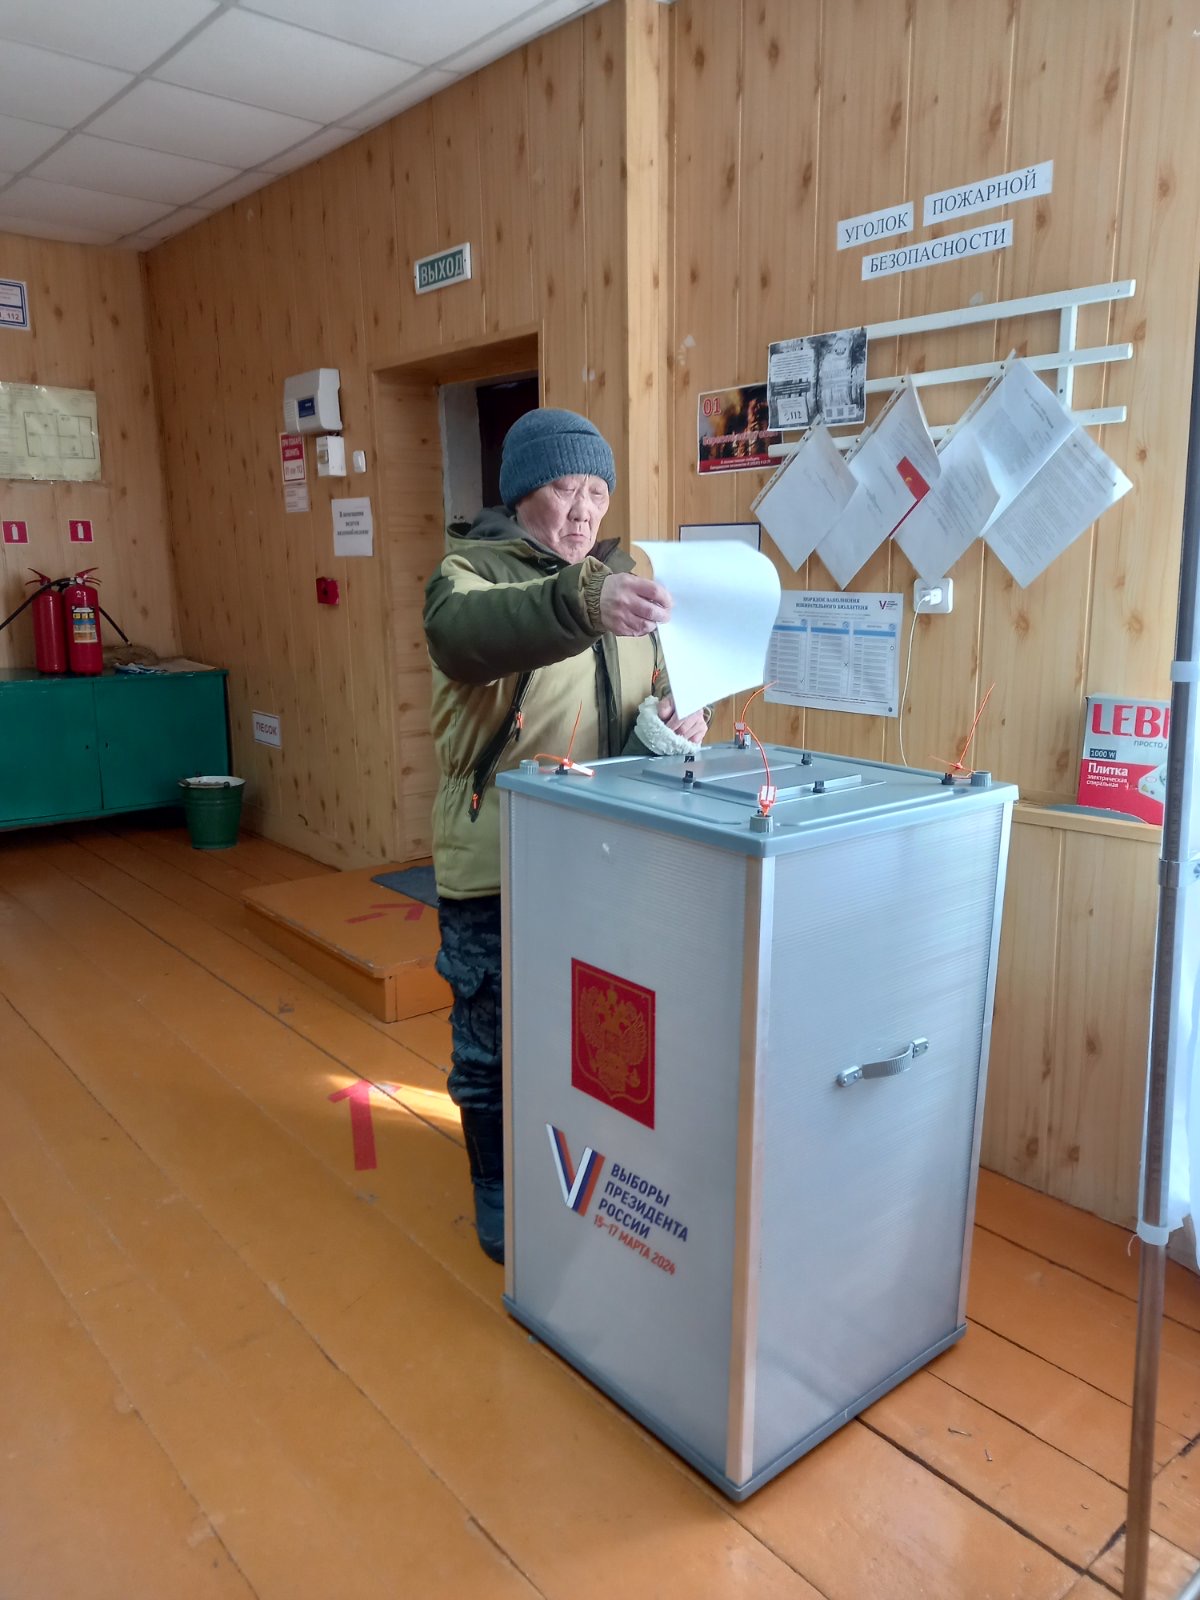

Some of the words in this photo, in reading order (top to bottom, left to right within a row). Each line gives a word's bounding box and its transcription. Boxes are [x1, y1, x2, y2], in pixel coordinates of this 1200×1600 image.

[845, 212, 908, 243] УГОЛОК
[932, 169, 1036, 215] ПОЖАРНОЙ
[870, 228, 1006, 273] БЕЗОПАСНОСТИ
[421, 254, 464, 286] ВЫХОД
[7, 312, 20, 321] 112
[703, 398, 721, 416] 01
[790, 410, 802, 420] 112
[256, 721, 277, 736] ПЕСОК
[1090, 749, 1107, 758] 1000
[1107, 750, 1116, 759] W
[1087, 774, 1128, 783] электрическая
[1088, 762, 1129, 776] Плитка
[611, 1163, 670, 1208] ВЫБОРЫ
[598, 1198, 651, 1239] РОССИИ
[604, 1180, 689, 1242] ПРЕЗИДЕНТА
[618, 1231, 650, 1259] МАРТА
[650, 1252, 677, 1275] 2024
